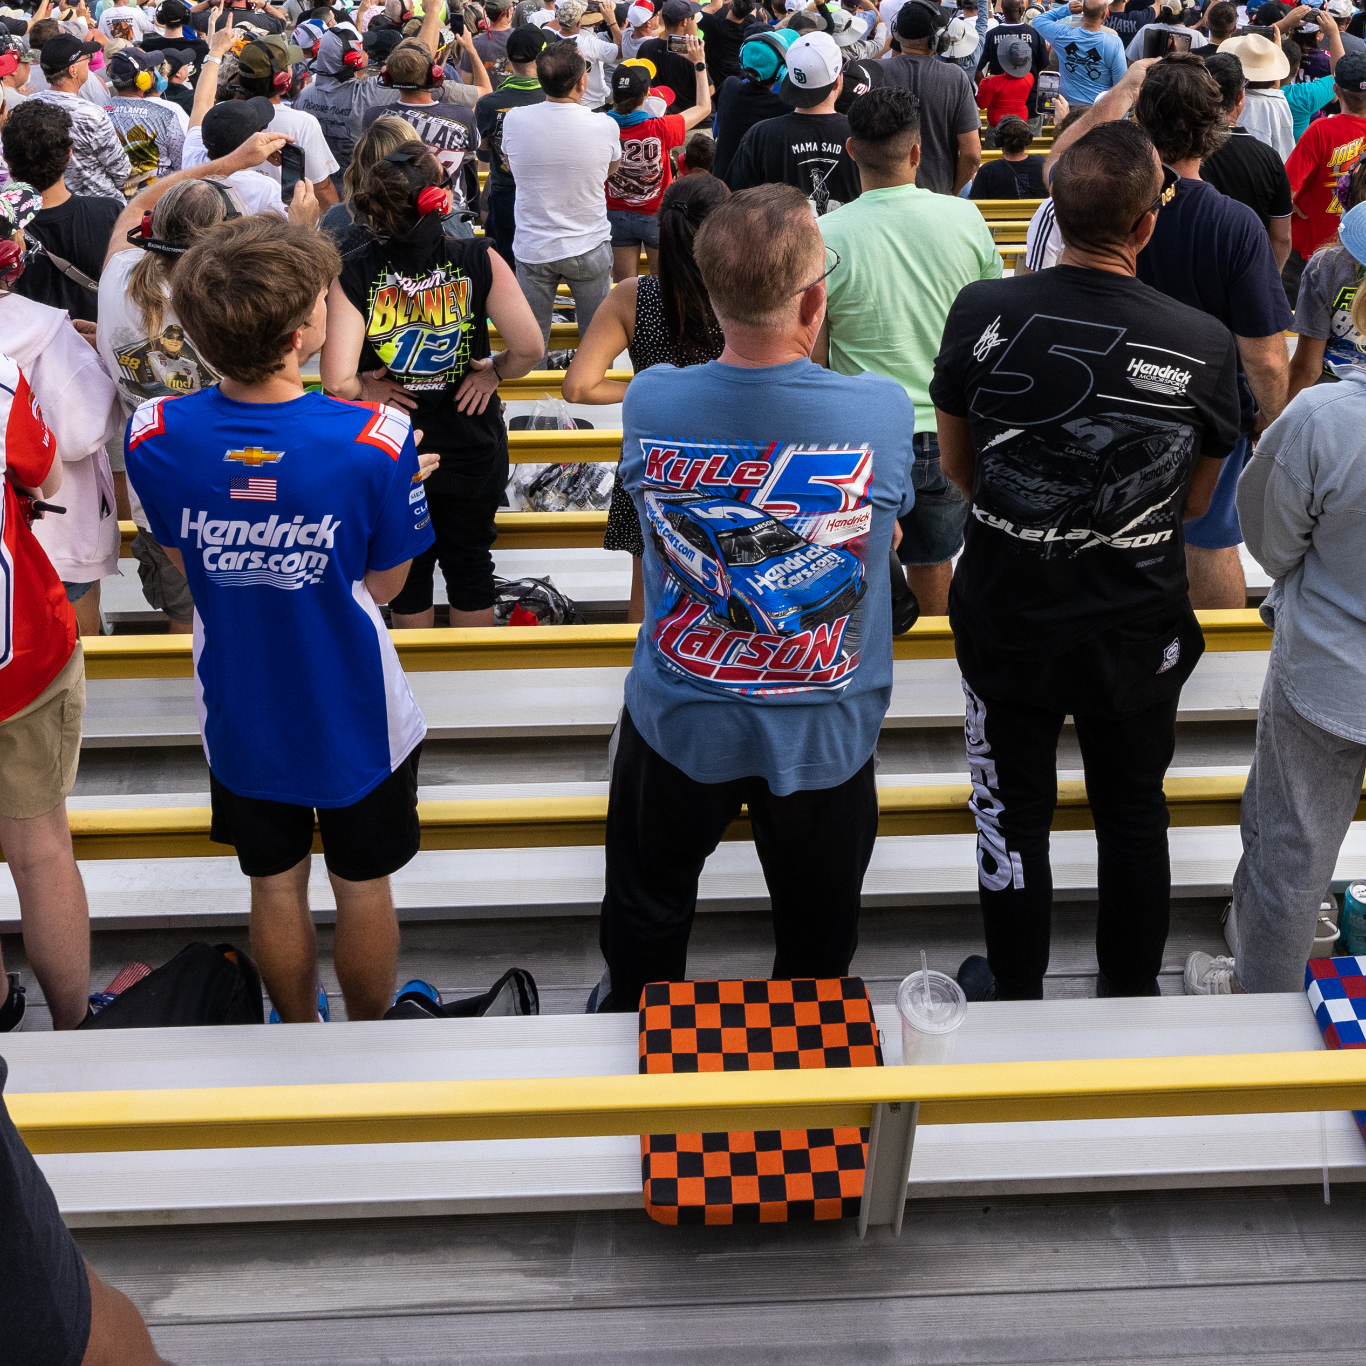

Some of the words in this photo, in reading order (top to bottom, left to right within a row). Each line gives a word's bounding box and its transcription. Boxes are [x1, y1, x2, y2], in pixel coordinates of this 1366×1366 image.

[619, 77, 630, 85] 20
[115, 106, 148, 114] ATLANTA
[626, 141, 657, 161] 20
[792, 143, 818, 154] MAMA
[821, 143, 842, 153] SAID
[368, 279, 472, 338] BLANEY
[119, 355, 140, 369] 88
[388, 328, 461, 375] 12
[1126, 358, 1192, 384] Hendrick
[403, 383, 446, 391] PENSKE
[1065, 446, 1100, 461] LARSON
[752, 449, 871, 514] 5
[181, 507, 342, 549] Hendrick
[827, 512, 870, 532] Hendrick
[202, 546, 329, 573] Cars.com
[746, 545, 829, 595] Hendrick
[778, 551, 839, 590] Cars.com
